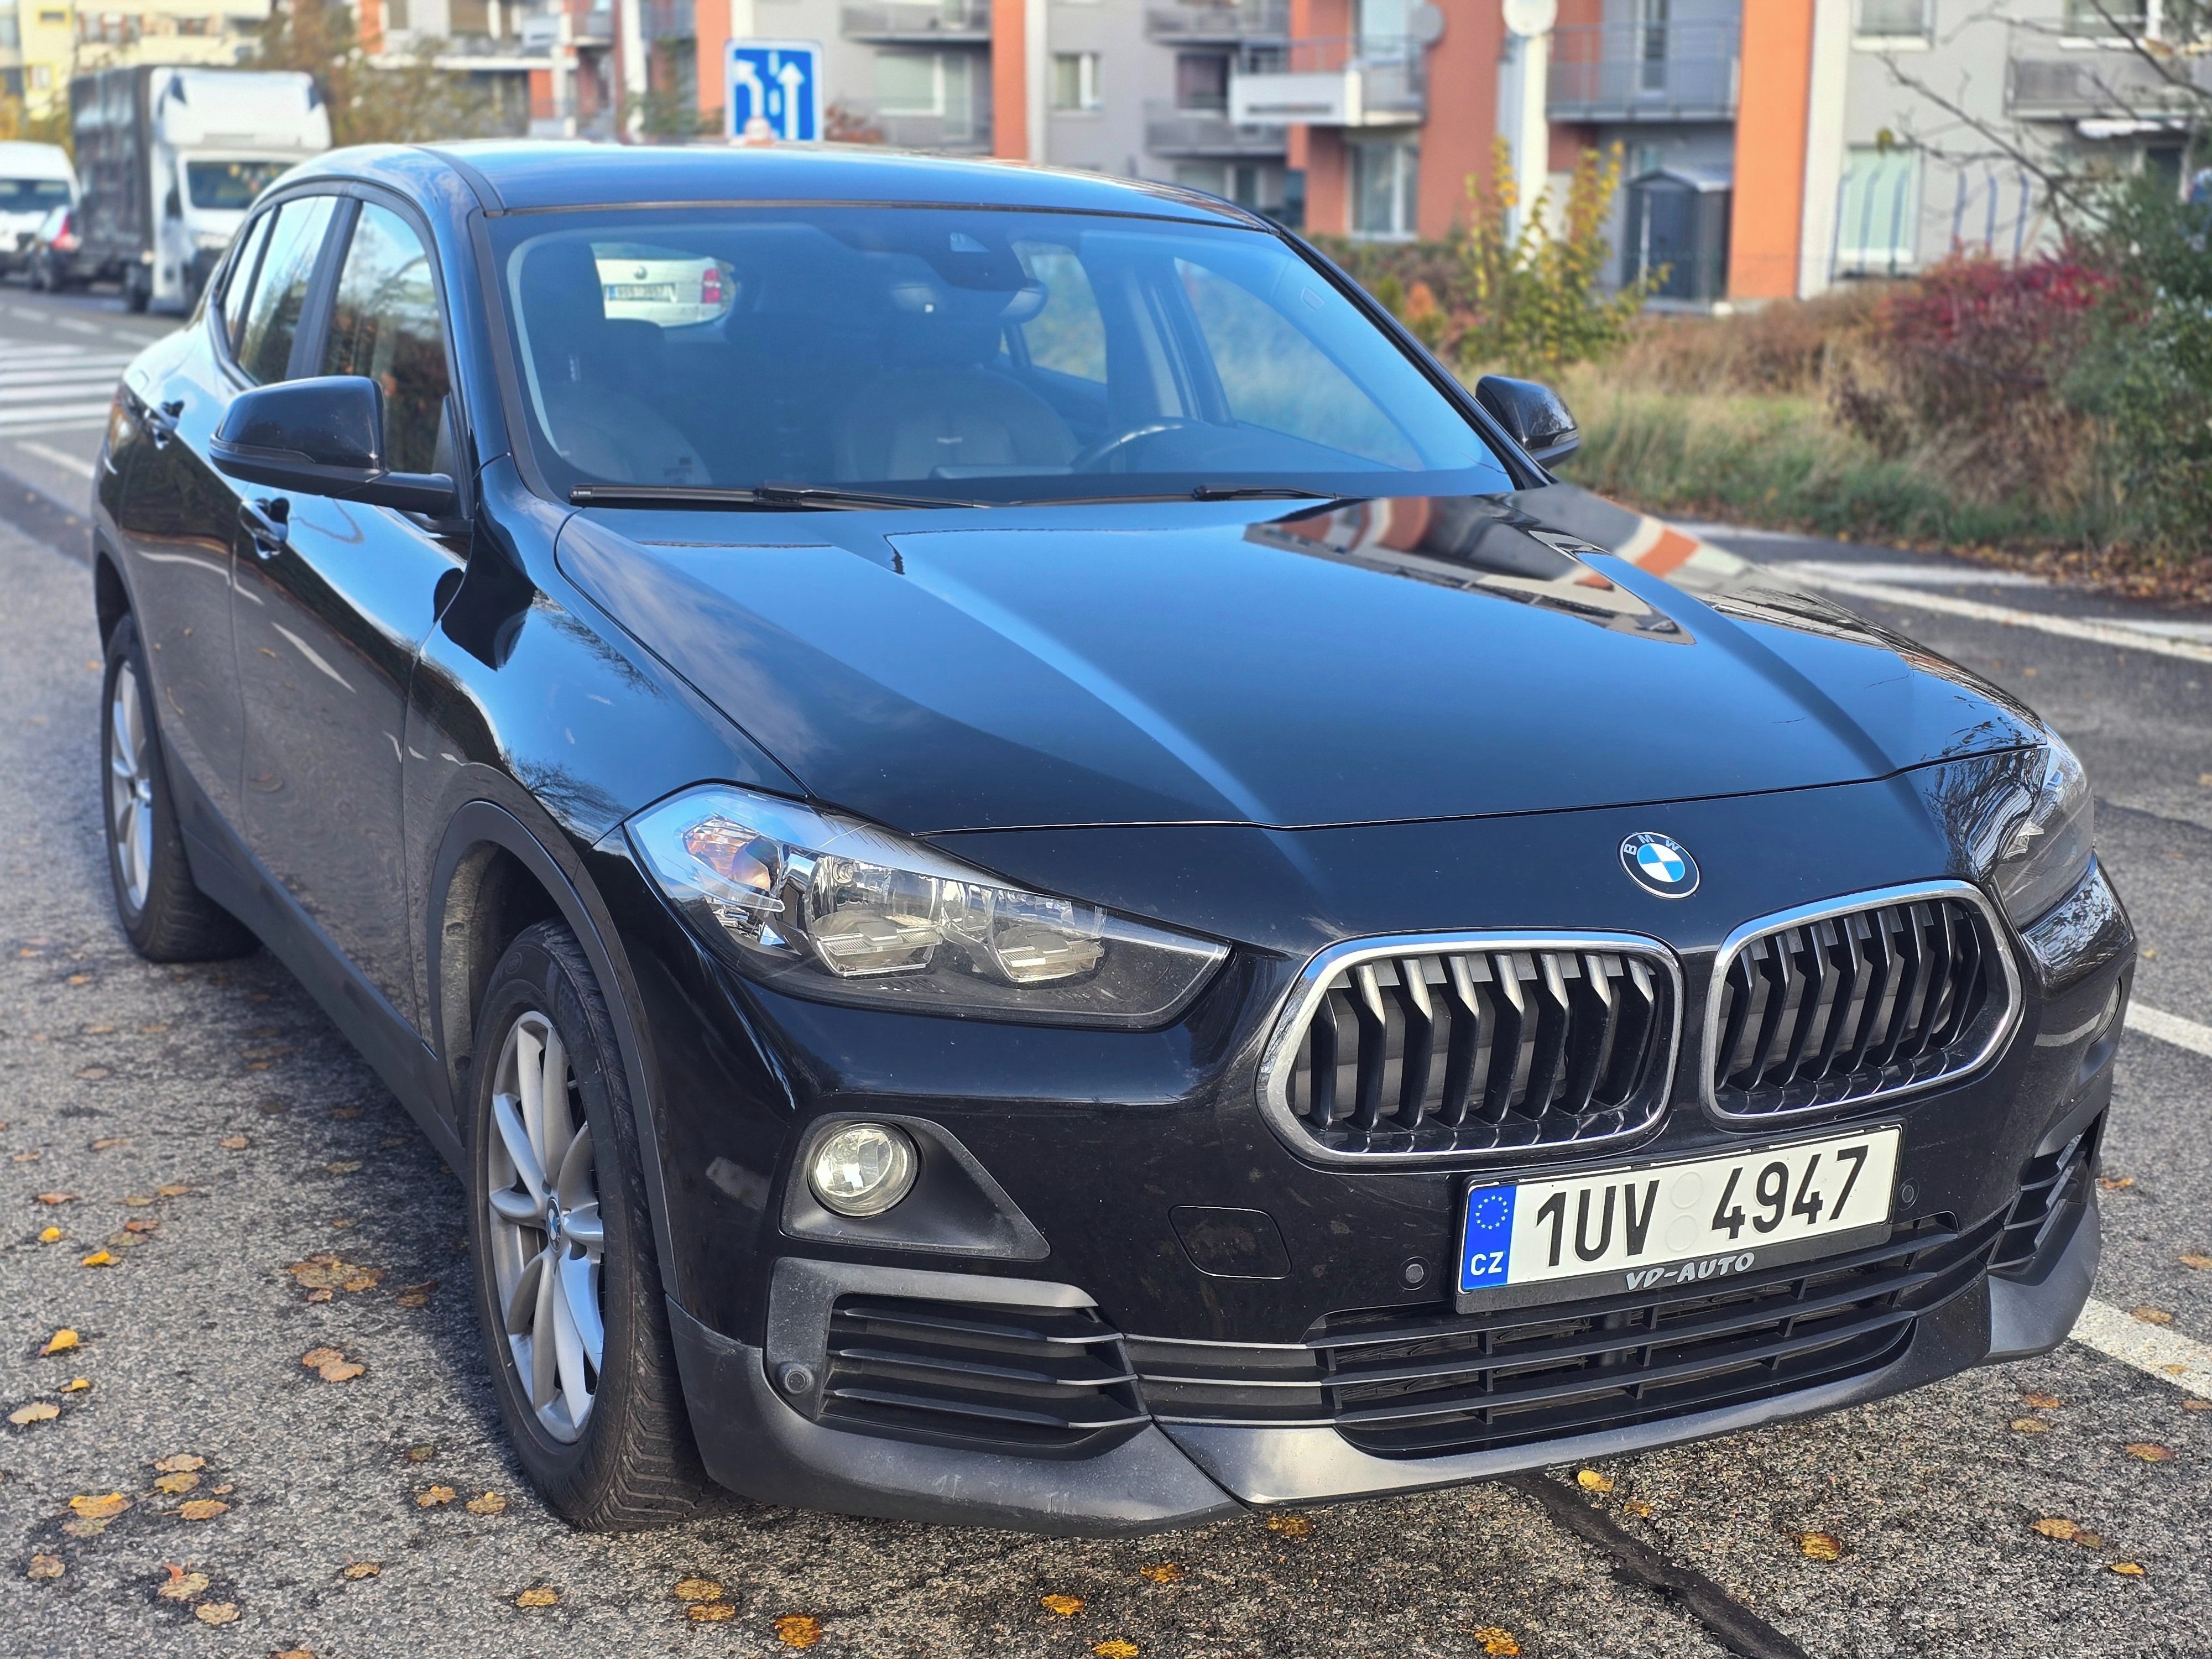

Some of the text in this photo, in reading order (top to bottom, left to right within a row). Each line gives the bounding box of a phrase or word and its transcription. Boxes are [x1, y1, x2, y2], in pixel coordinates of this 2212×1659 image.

[1624, 834, 1680, 855] BMW
[1535, 1145, 1868, 1267] 1UV 4947
[1471, 1251, 1504, 1276] CZ
[1626, 1252, 1755, 1290] VD-AUTO
